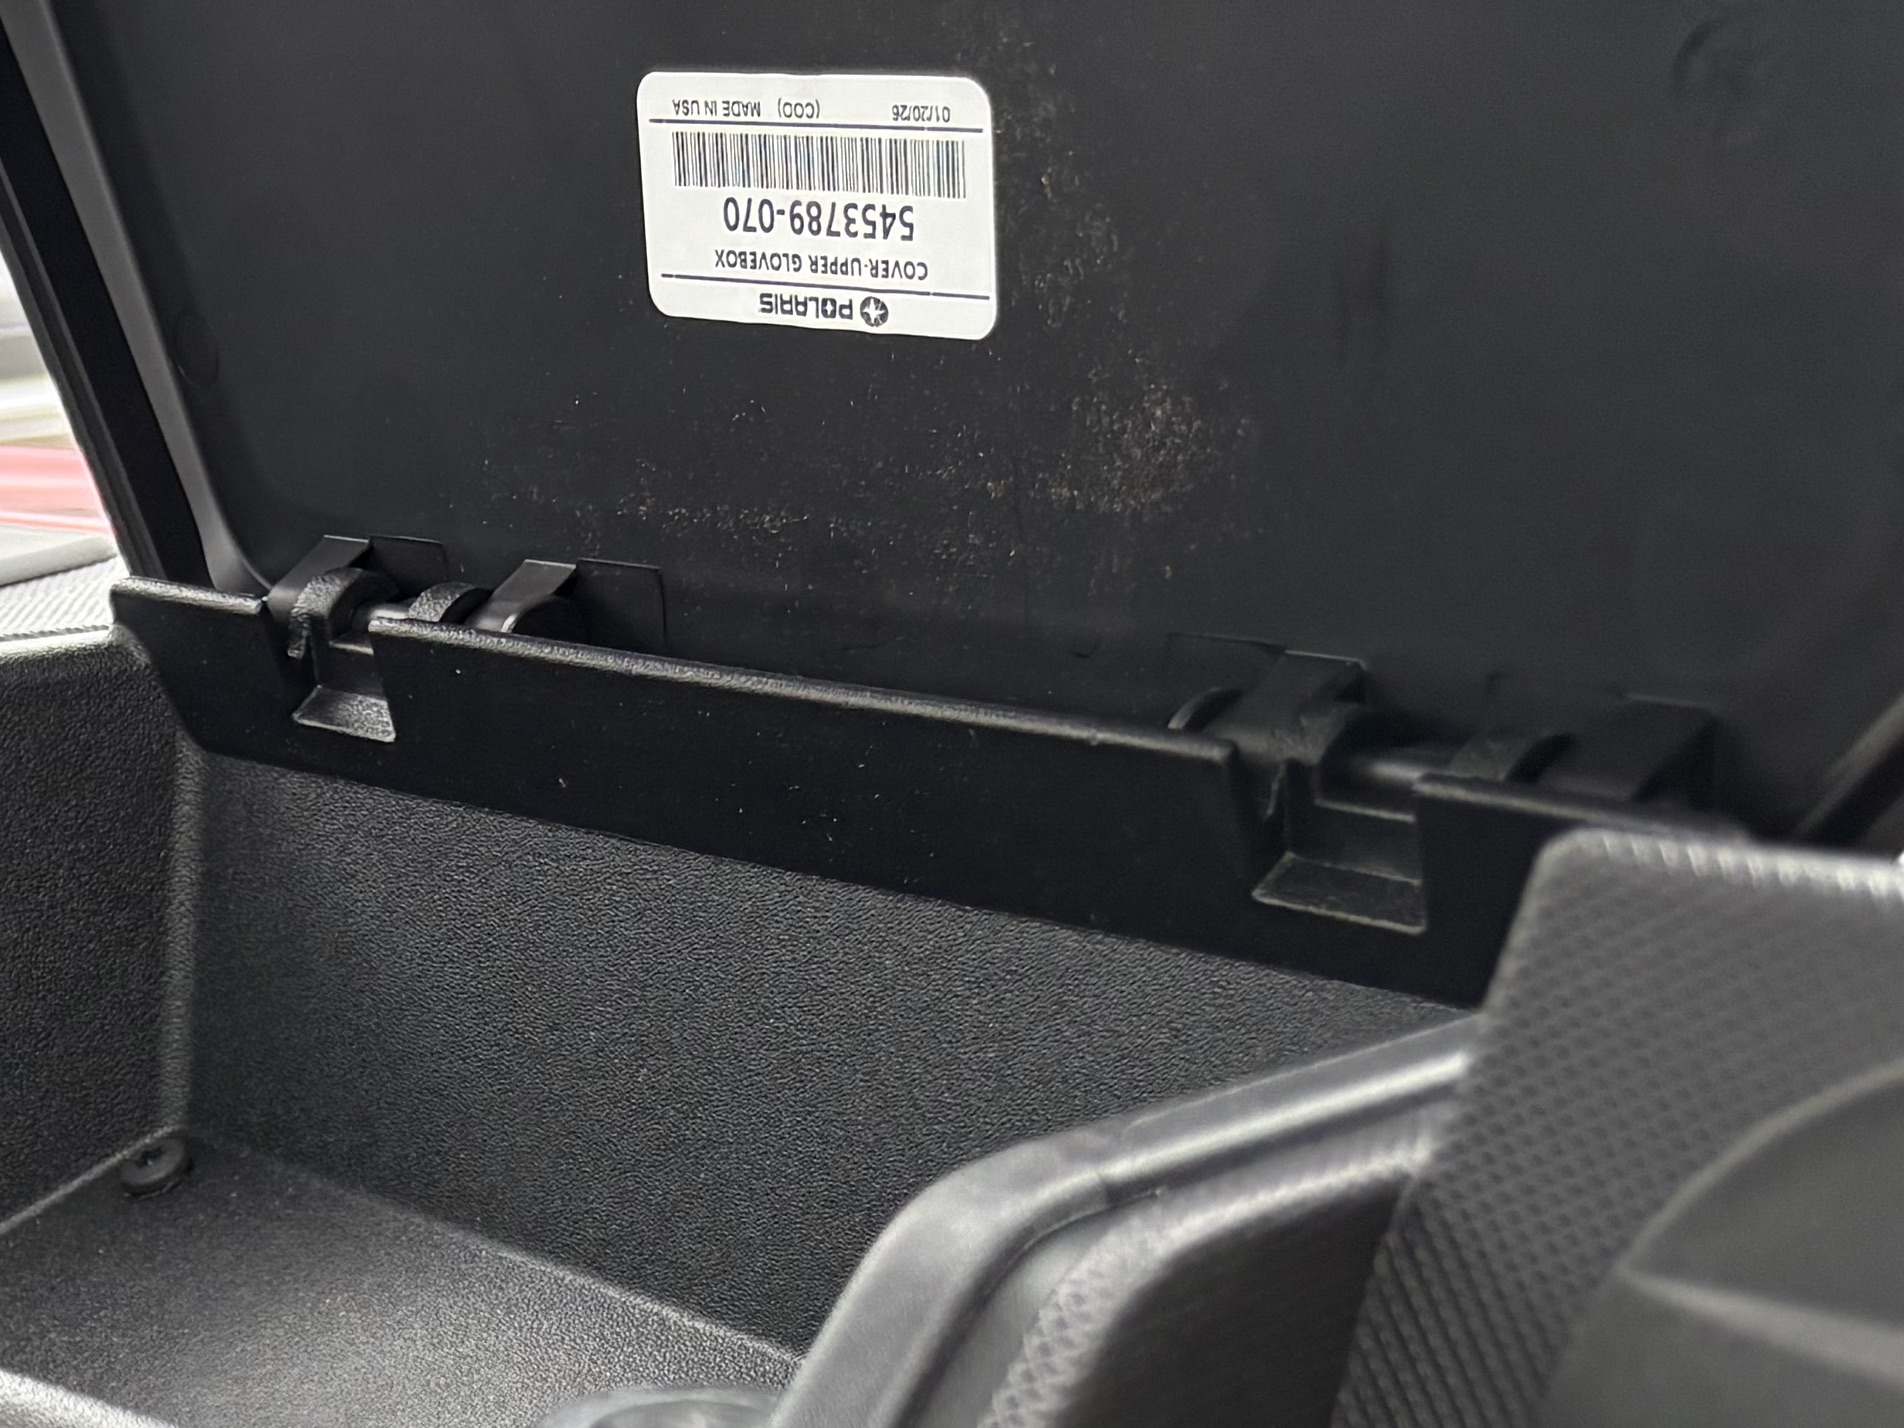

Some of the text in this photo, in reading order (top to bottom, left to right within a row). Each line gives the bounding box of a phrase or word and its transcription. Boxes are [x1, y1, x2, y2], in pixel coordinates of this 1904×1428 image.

[672, 99, 700, 116] USA
[704, 100, 718, 116] IN
[722, 100, 761, 117] MADE
[892, 104, 951, 123] 01/20/26
[723, 197, 915, 241] 5453789-070
[714, 249, 929, 281] COVER-UPPER GLOVEBOX
[758, 292, 853, 320] POLARIS
